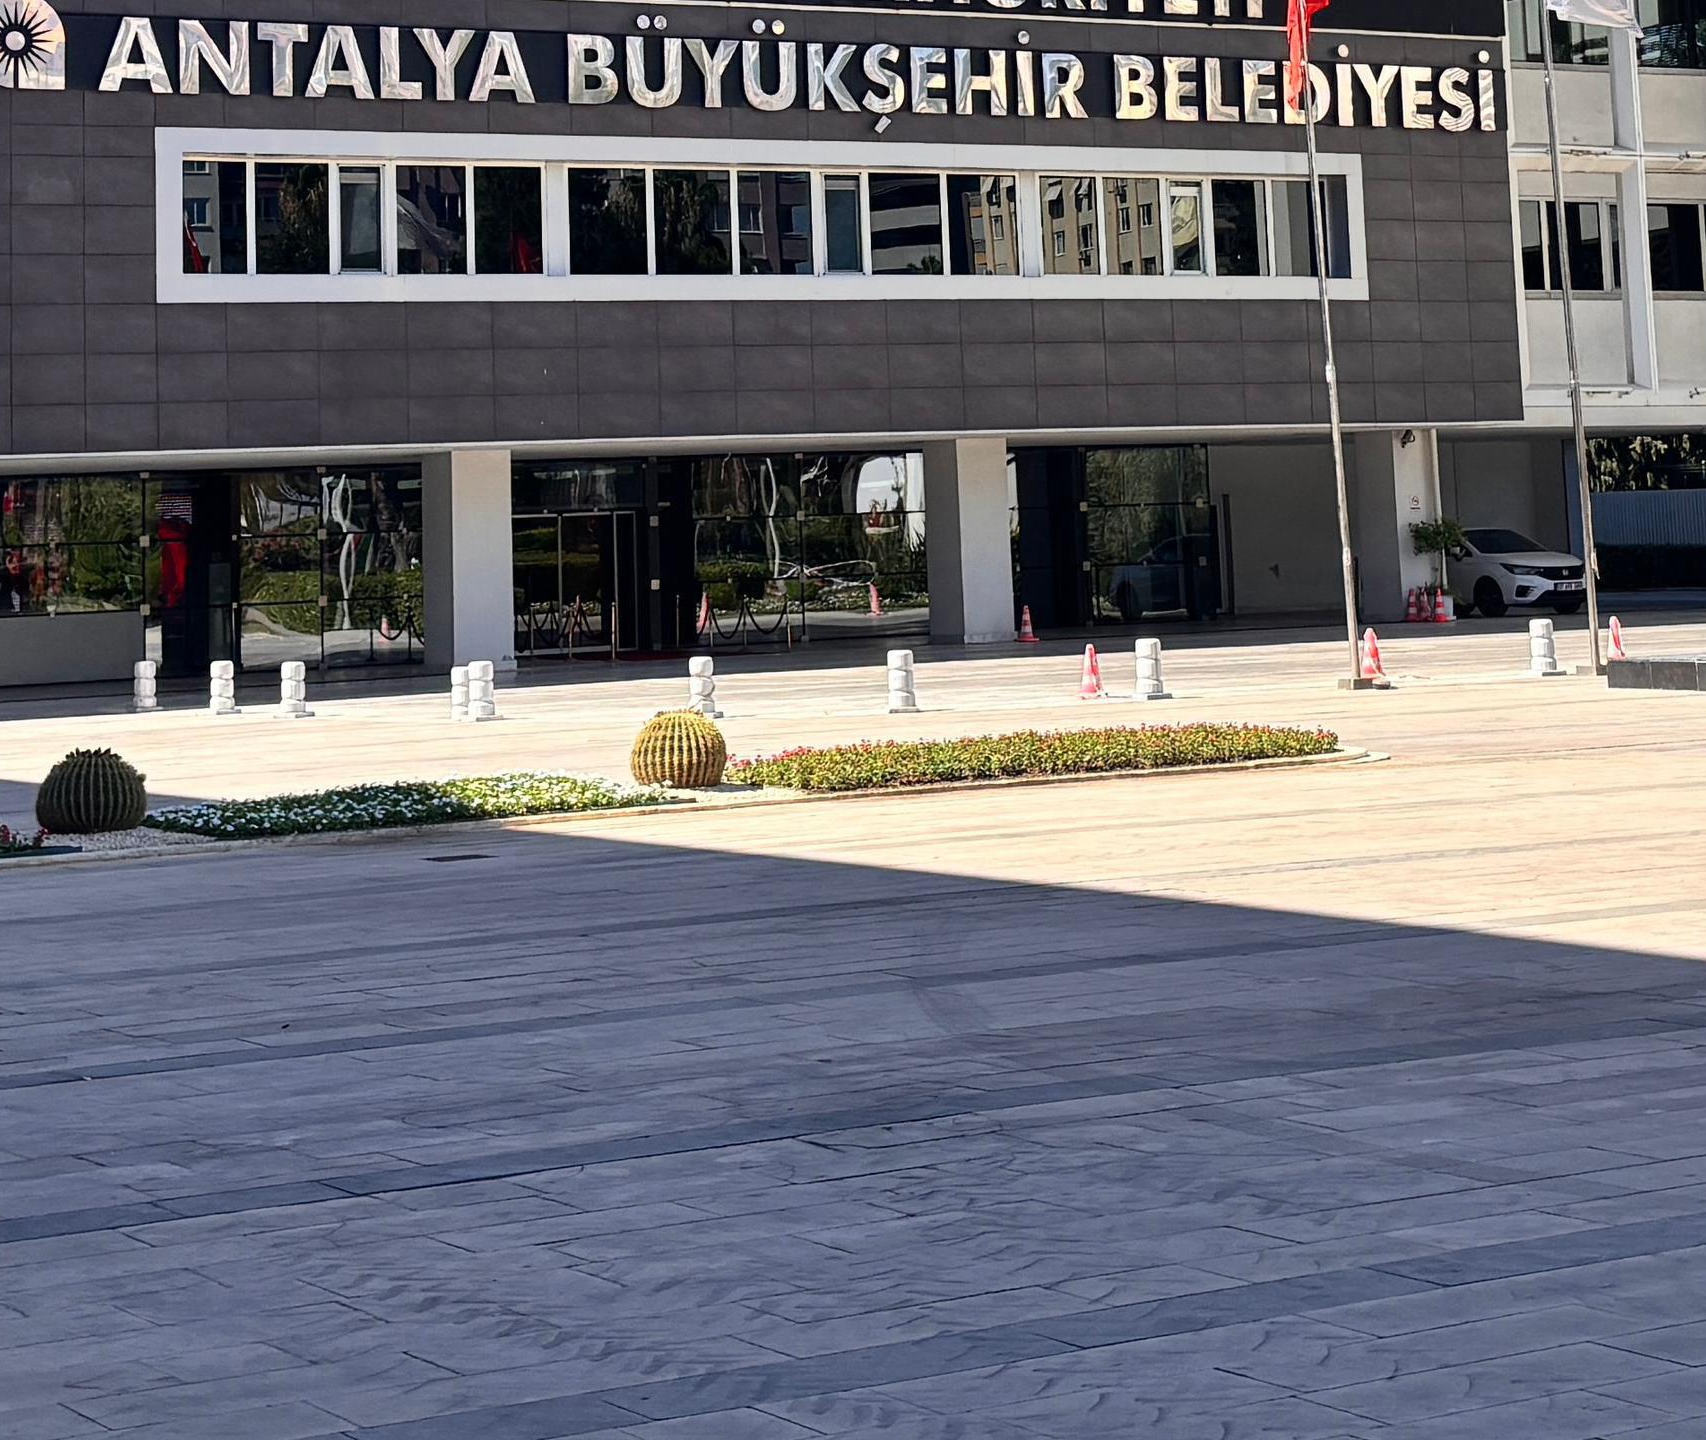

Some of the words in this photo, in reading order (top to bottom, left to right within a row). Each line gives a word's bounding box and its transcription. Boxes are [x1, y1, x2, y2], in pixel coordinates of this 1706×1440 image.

[97, 15, 536, 105] ANTALYA
[567, 13, 1089, 134] BÜYÜKŞEHİR
[1114, 44, 1497, 132] BELEDİYESİ
